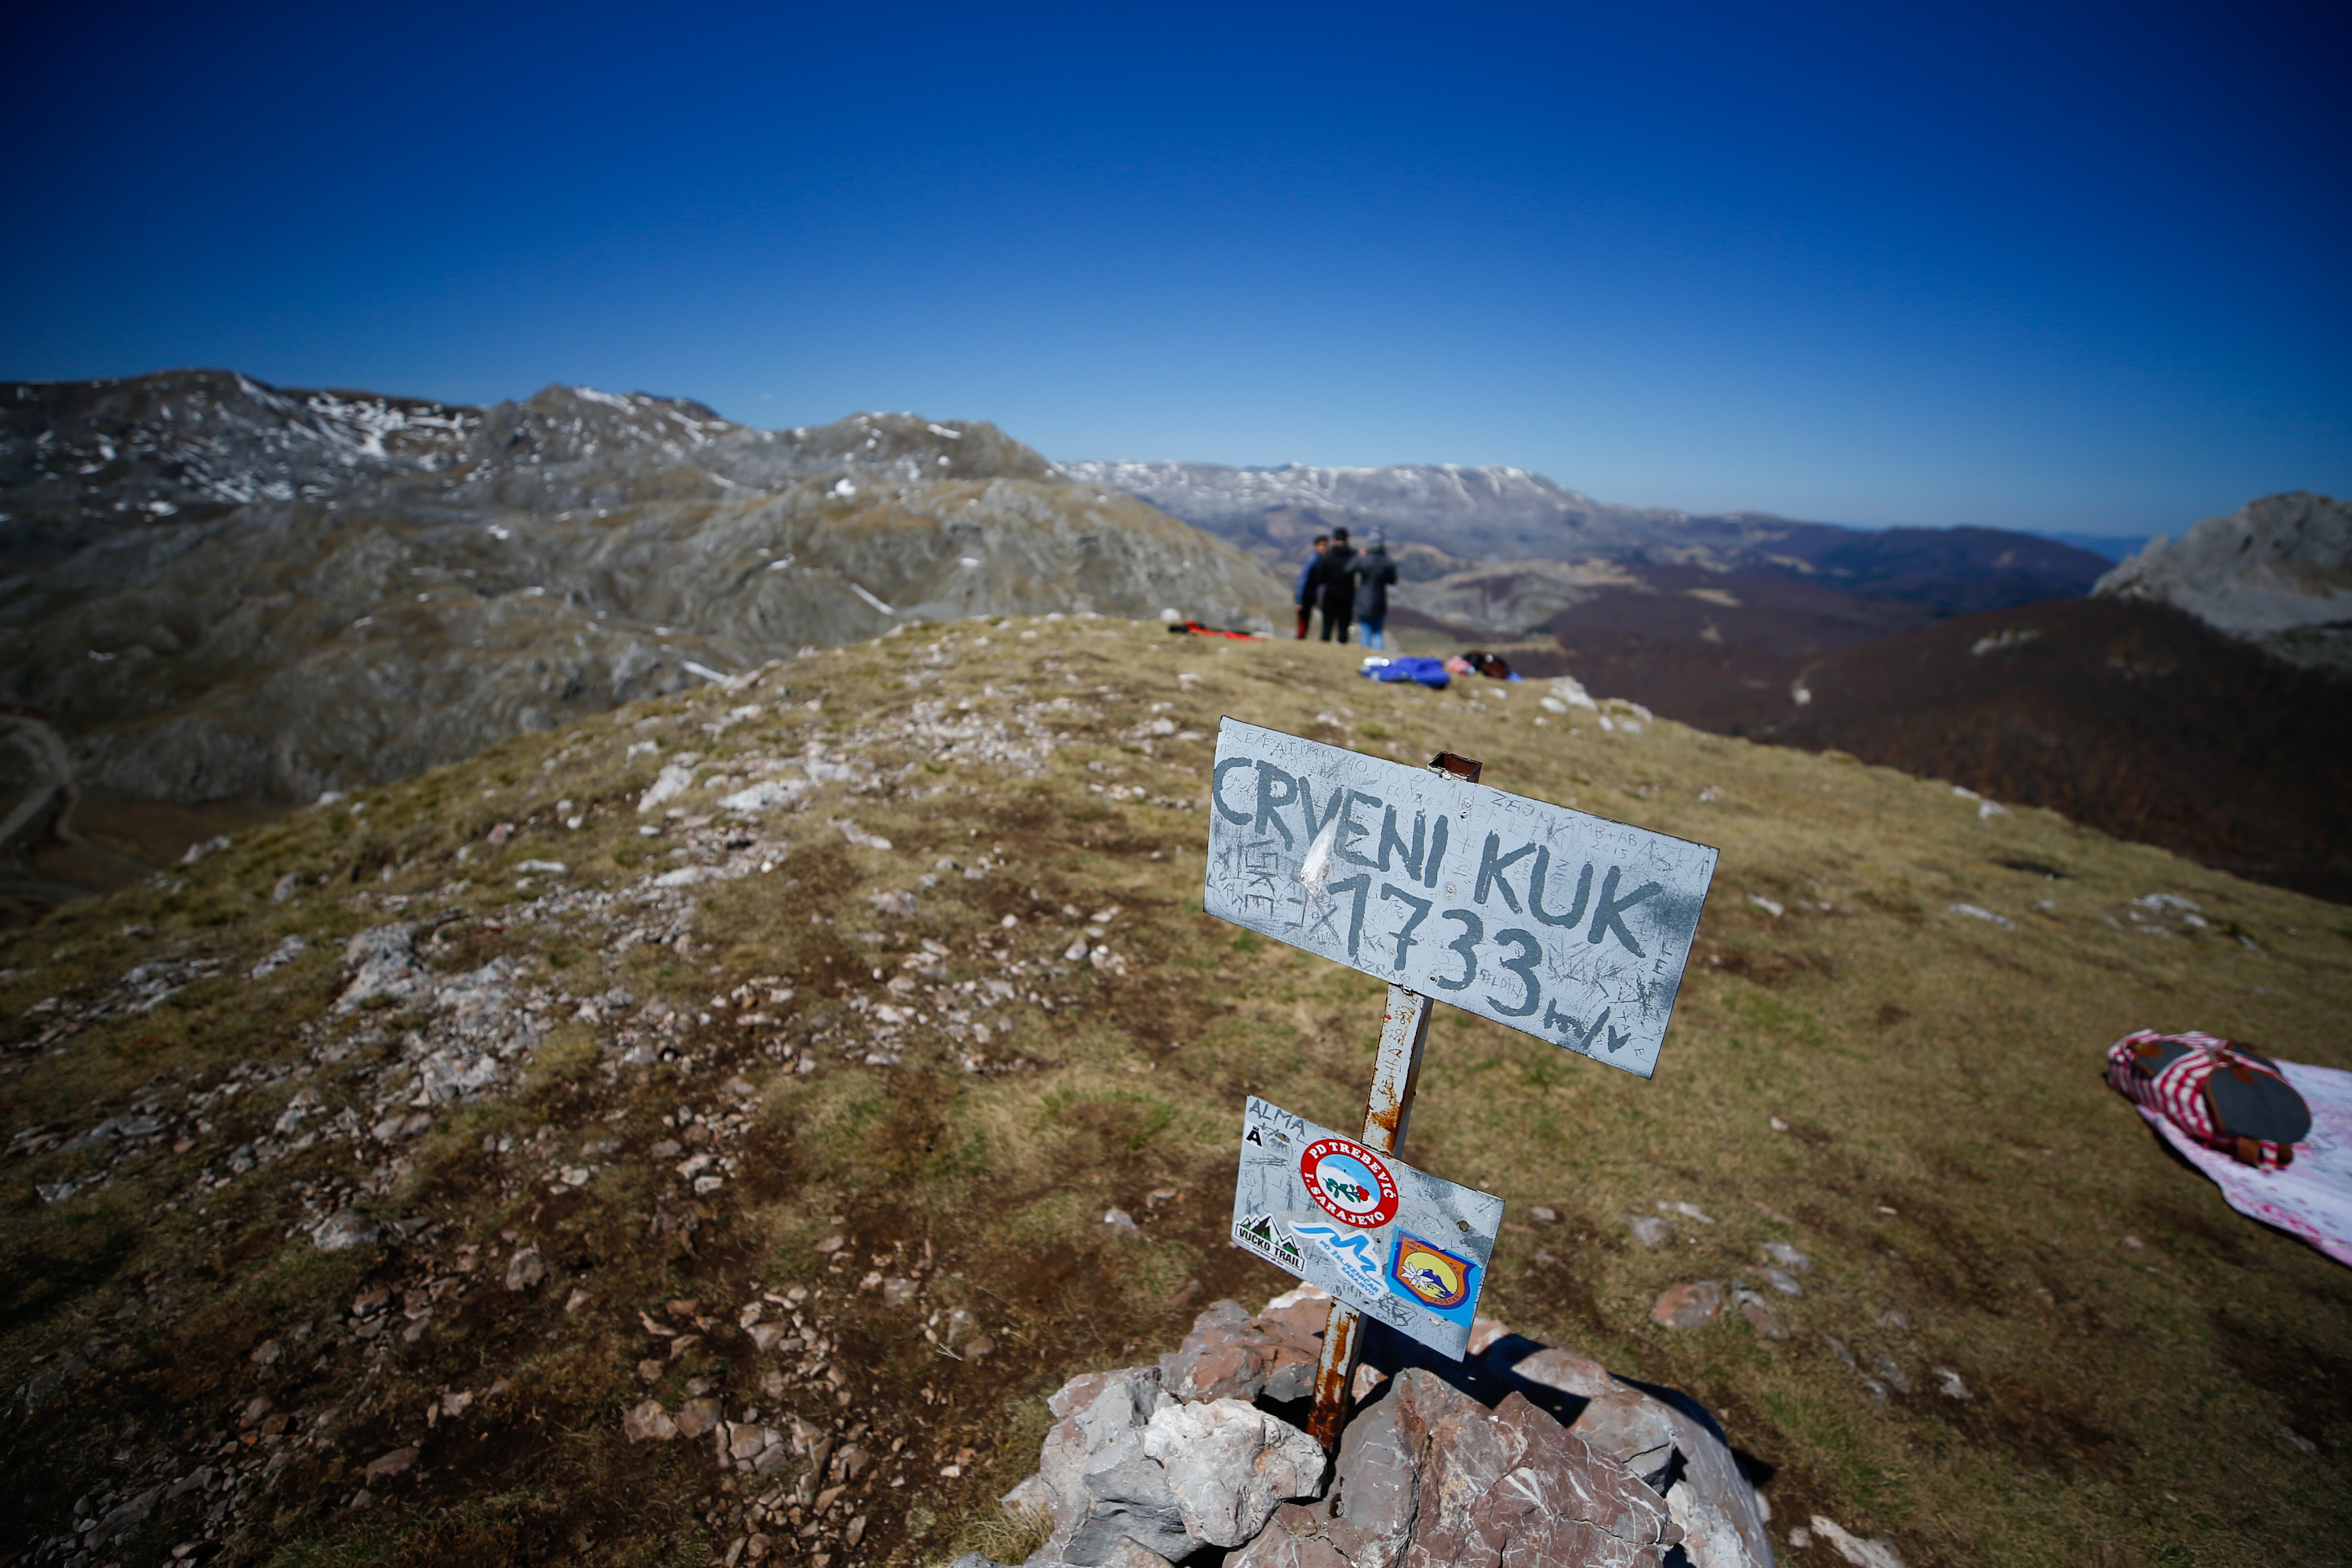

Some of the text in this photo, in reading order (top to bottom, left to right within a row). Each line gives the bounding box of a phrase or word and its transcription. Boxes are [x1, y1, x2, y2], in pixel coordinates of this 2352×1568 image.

[1212, 757, 1449, 888] CRVENI
[1474, 829, 1663, 958] KUK
[1327, 873, 1543, 1018] 1733
[1249, 1099, 1305, 1138] ALMA
[1308, 1144, 1327, 1159] PD
[1310, 1186, 1385, 1225] SARAJEVO
[1240, 1228, 1270, 1251] VUCKO
[1274, 1247, 1301, 1269] TRAIL
[1319, 1240, 1330, 1250] PD
[1330, 1250, 1380, 1293] ŽELJEZNIČAR
[1341, 1266, 1375, 1296] SARAJEVO
